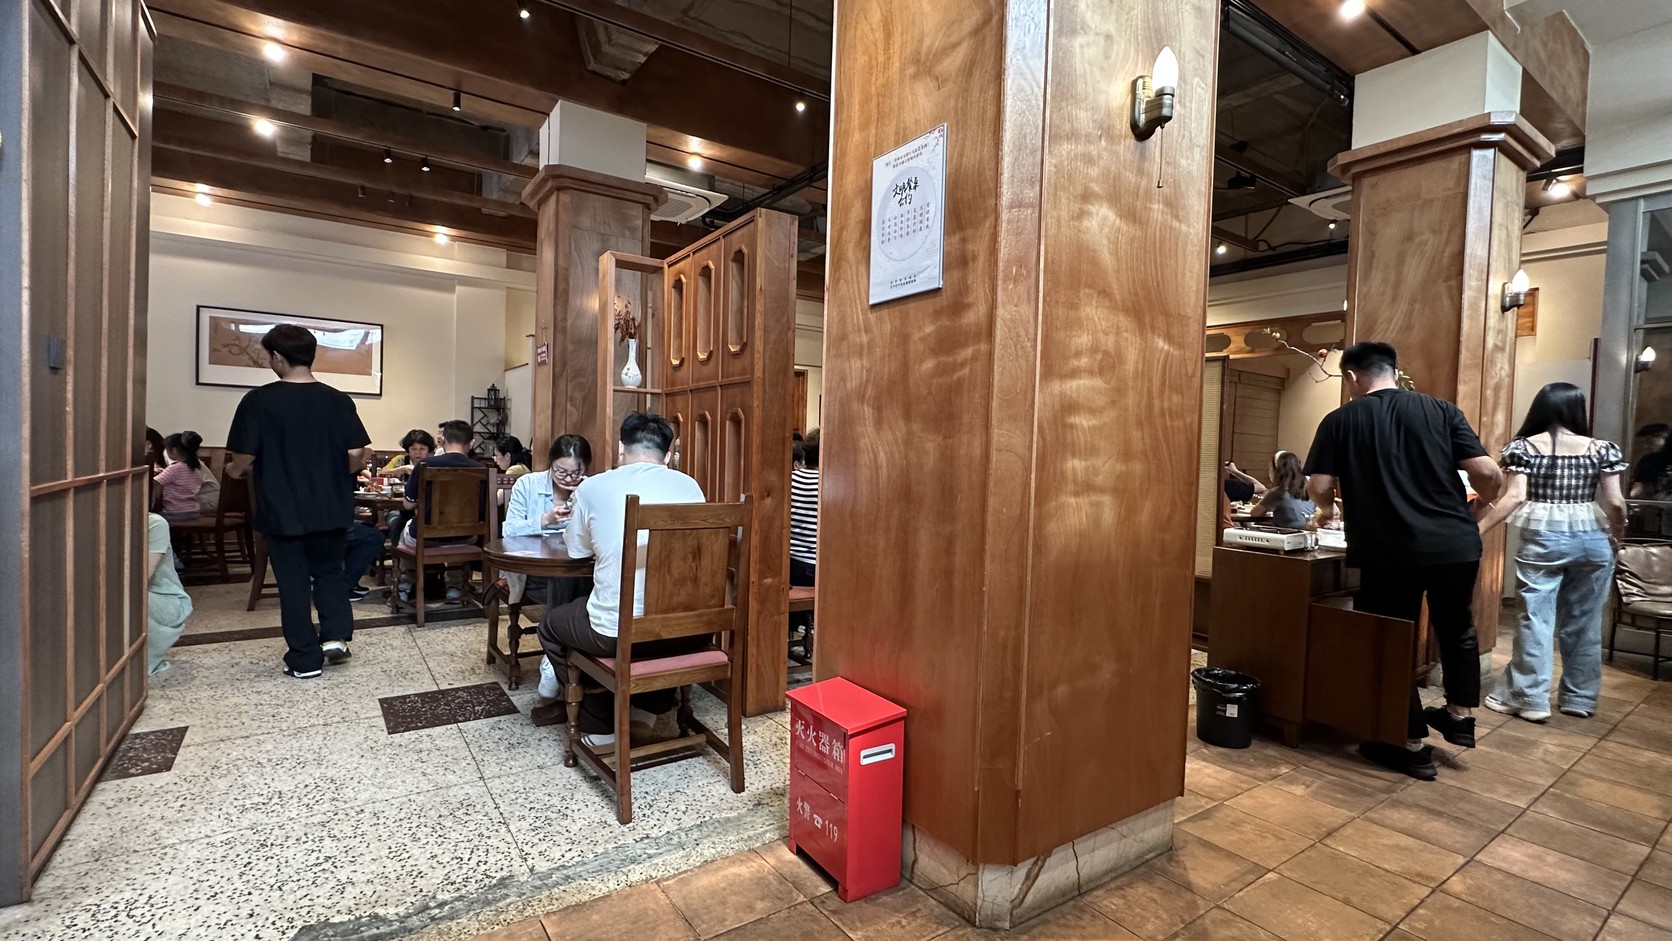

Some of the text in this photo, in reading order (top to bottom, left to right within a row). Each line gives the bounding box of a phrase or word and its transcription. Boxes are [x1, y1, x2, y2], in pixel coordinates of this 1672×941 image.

[795, 717, 843, 764] 灭火器箱
[796, 796, 838, 842] 火警 119
